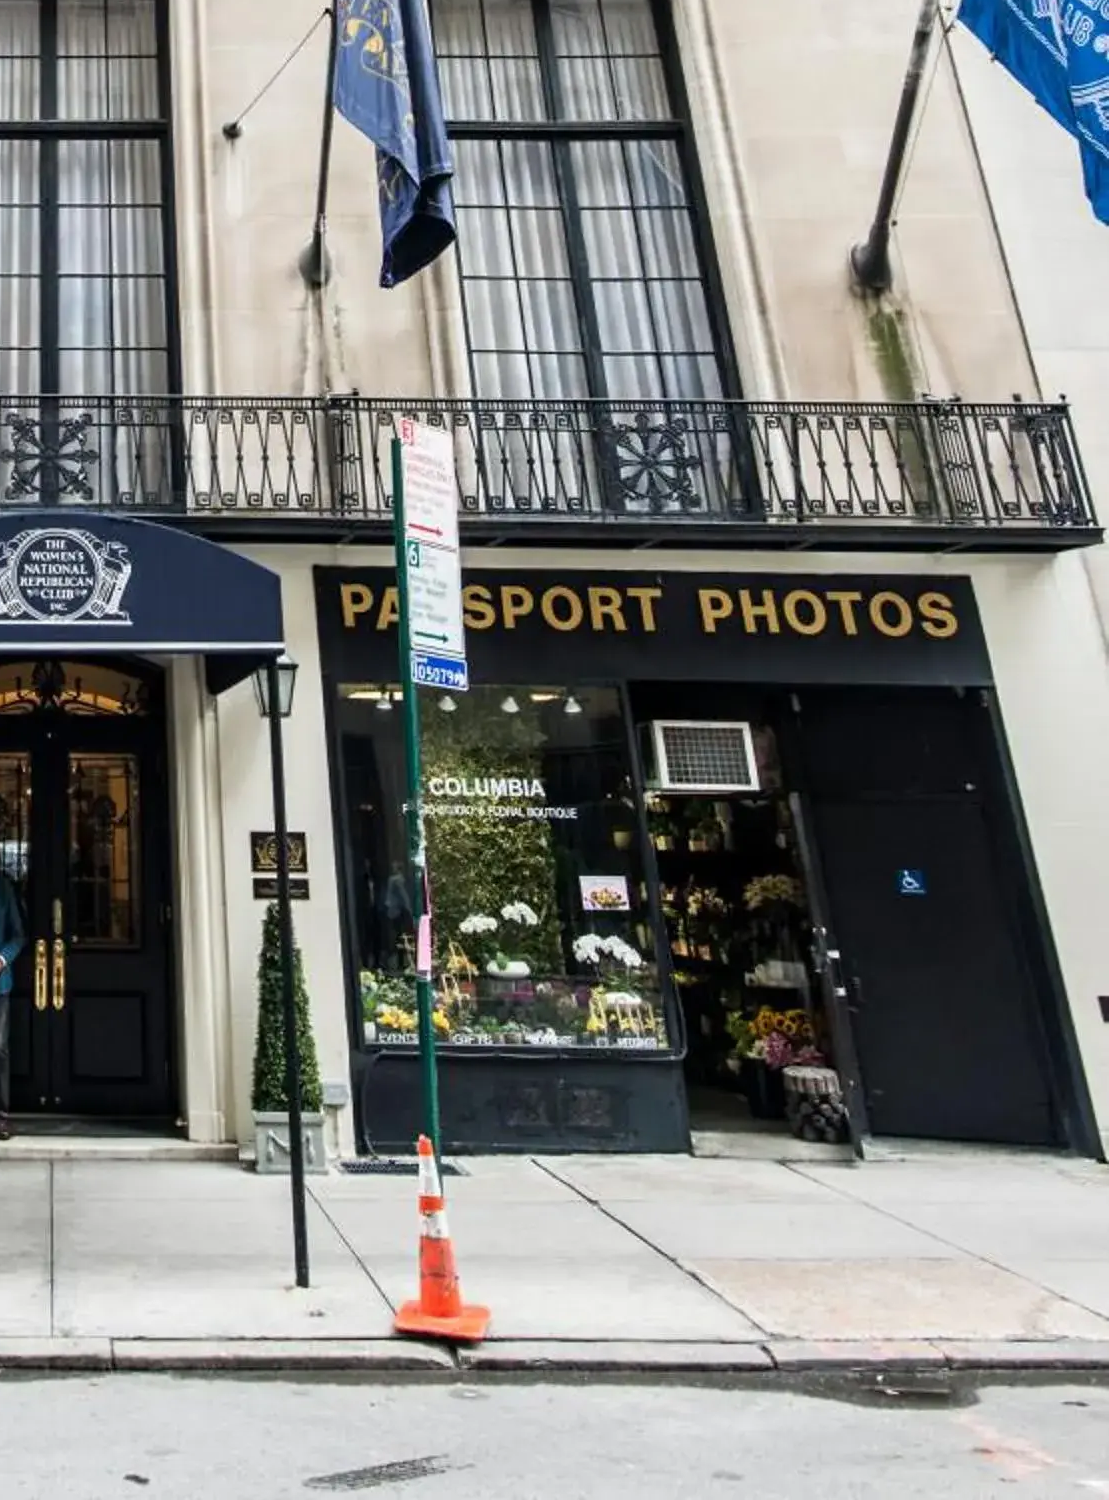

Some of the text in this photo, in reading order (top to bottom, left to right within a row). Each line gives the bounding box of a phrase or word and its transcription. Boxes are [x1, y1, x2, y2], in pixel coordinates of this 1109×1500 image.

[44, 539, 67, 549] THE
[30, 551, 85, 561] WOMEN'S
[23, 563, 88, 574] NATIONAL
[19, 576, 94, 587] REPUBLICAN
[40, 589, 75, 600] CLUB
[340, 582, 960, 638] PASPORT PHOTOS
[428, 776, 546, 798] COLUMBIA
[526, 806, 579, 819] BOUTIQUE
